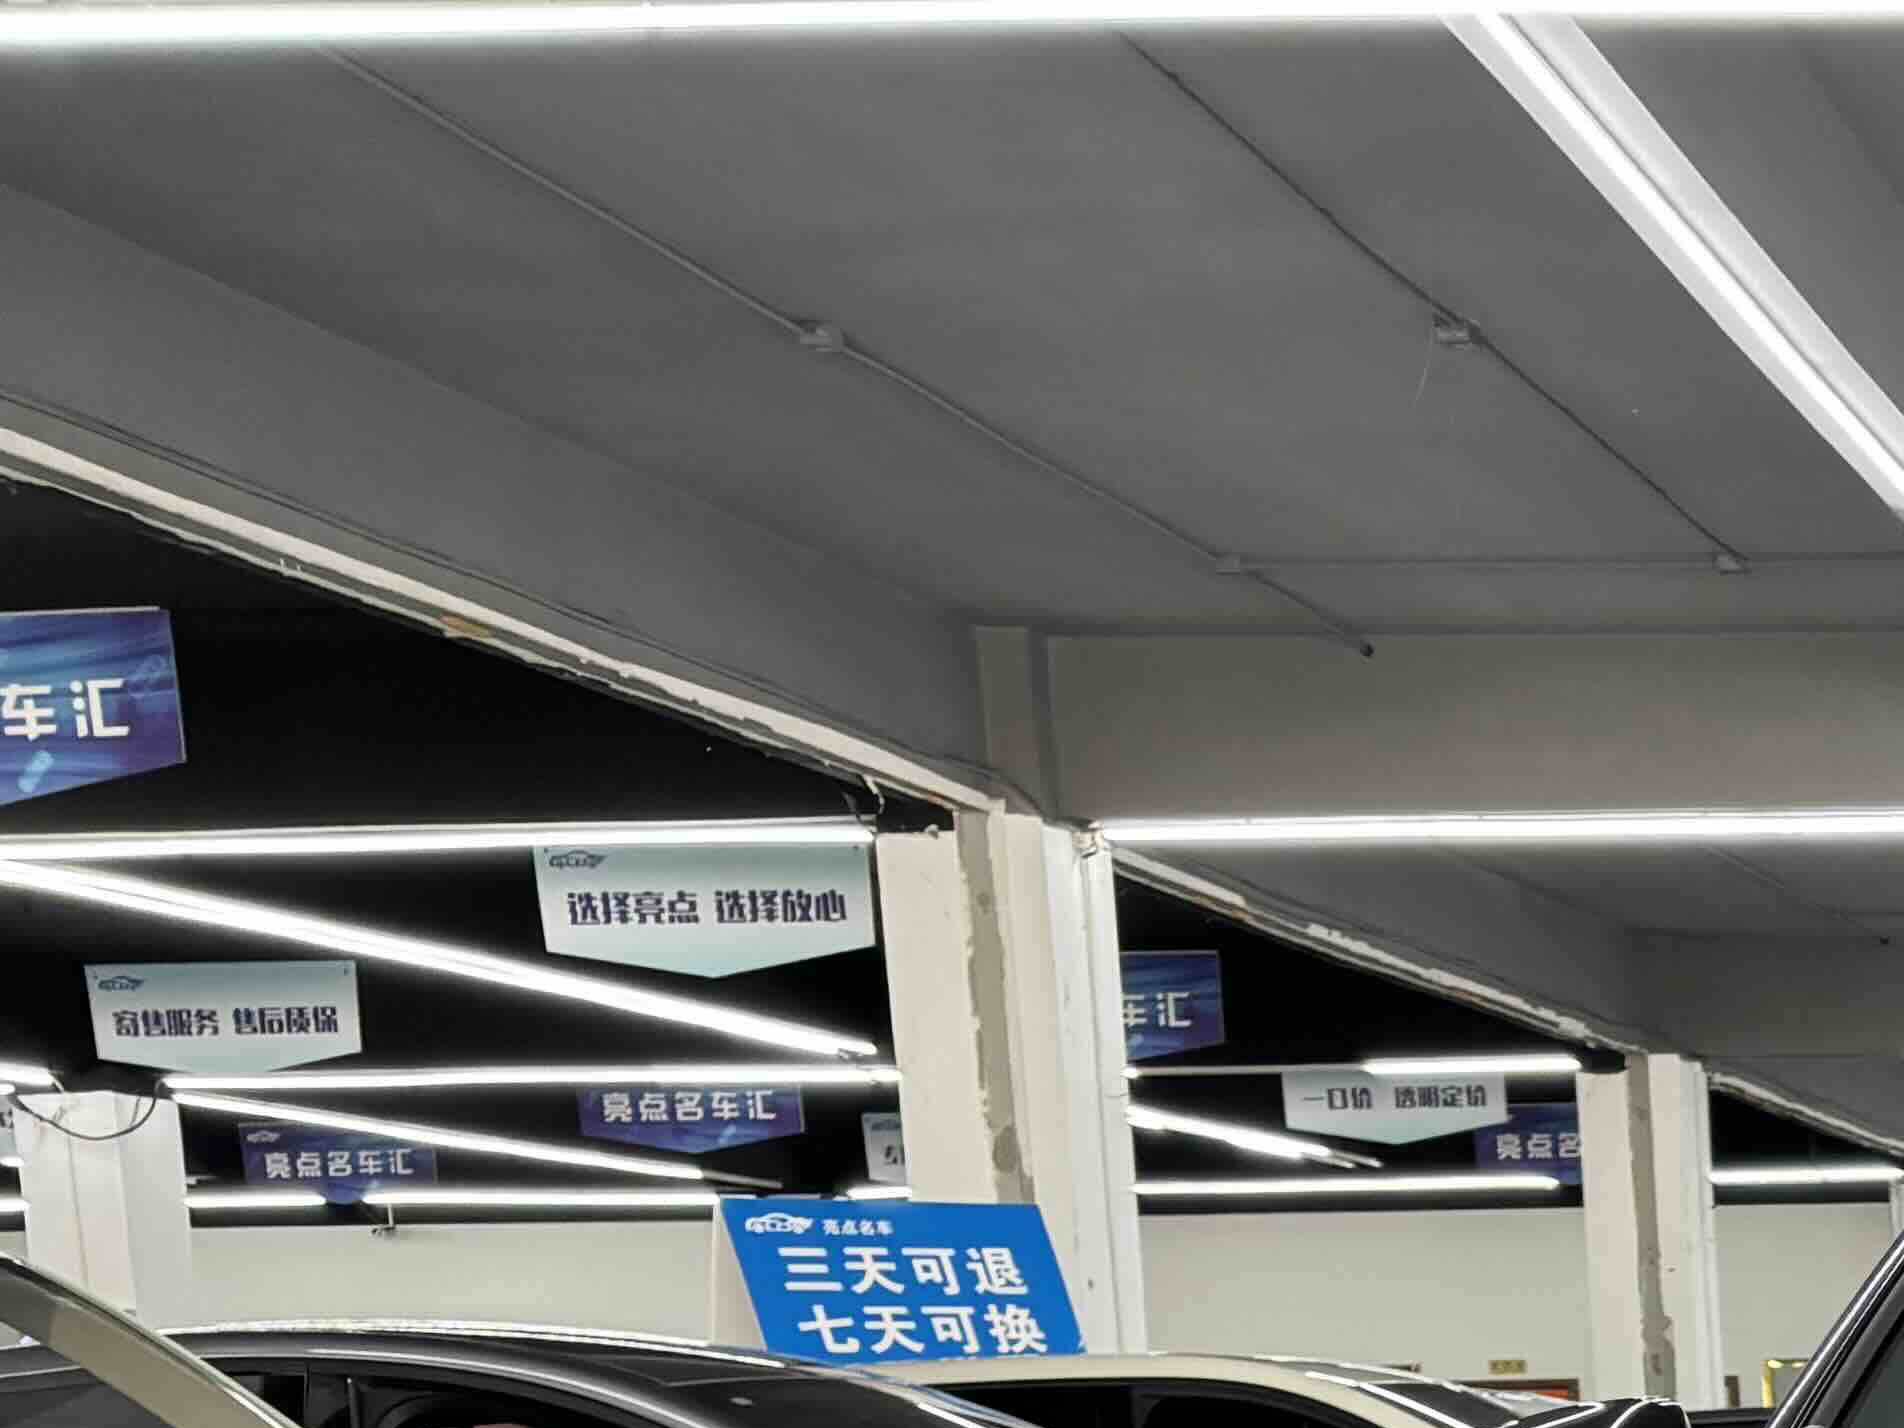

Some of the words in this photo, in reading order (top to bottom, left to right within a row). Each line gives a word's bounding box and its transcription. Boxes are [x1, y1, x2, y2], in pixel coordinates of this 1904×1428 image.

[0, 677, 131, 741] 车汇
[567, 890, 700, 926] 选择亮点
[714, 889, 848, 924] 选择放心
[601, 1089, 777, 1123] 亮点名车汇
[264, 1148, 414, 1179] 亮点名车汇
[1496, 1132, 1582, 1160] 亮点名
[777, 1246, 1029, 1296] 三天可退
[797, 1303, 1048, 1354] 七天可换
